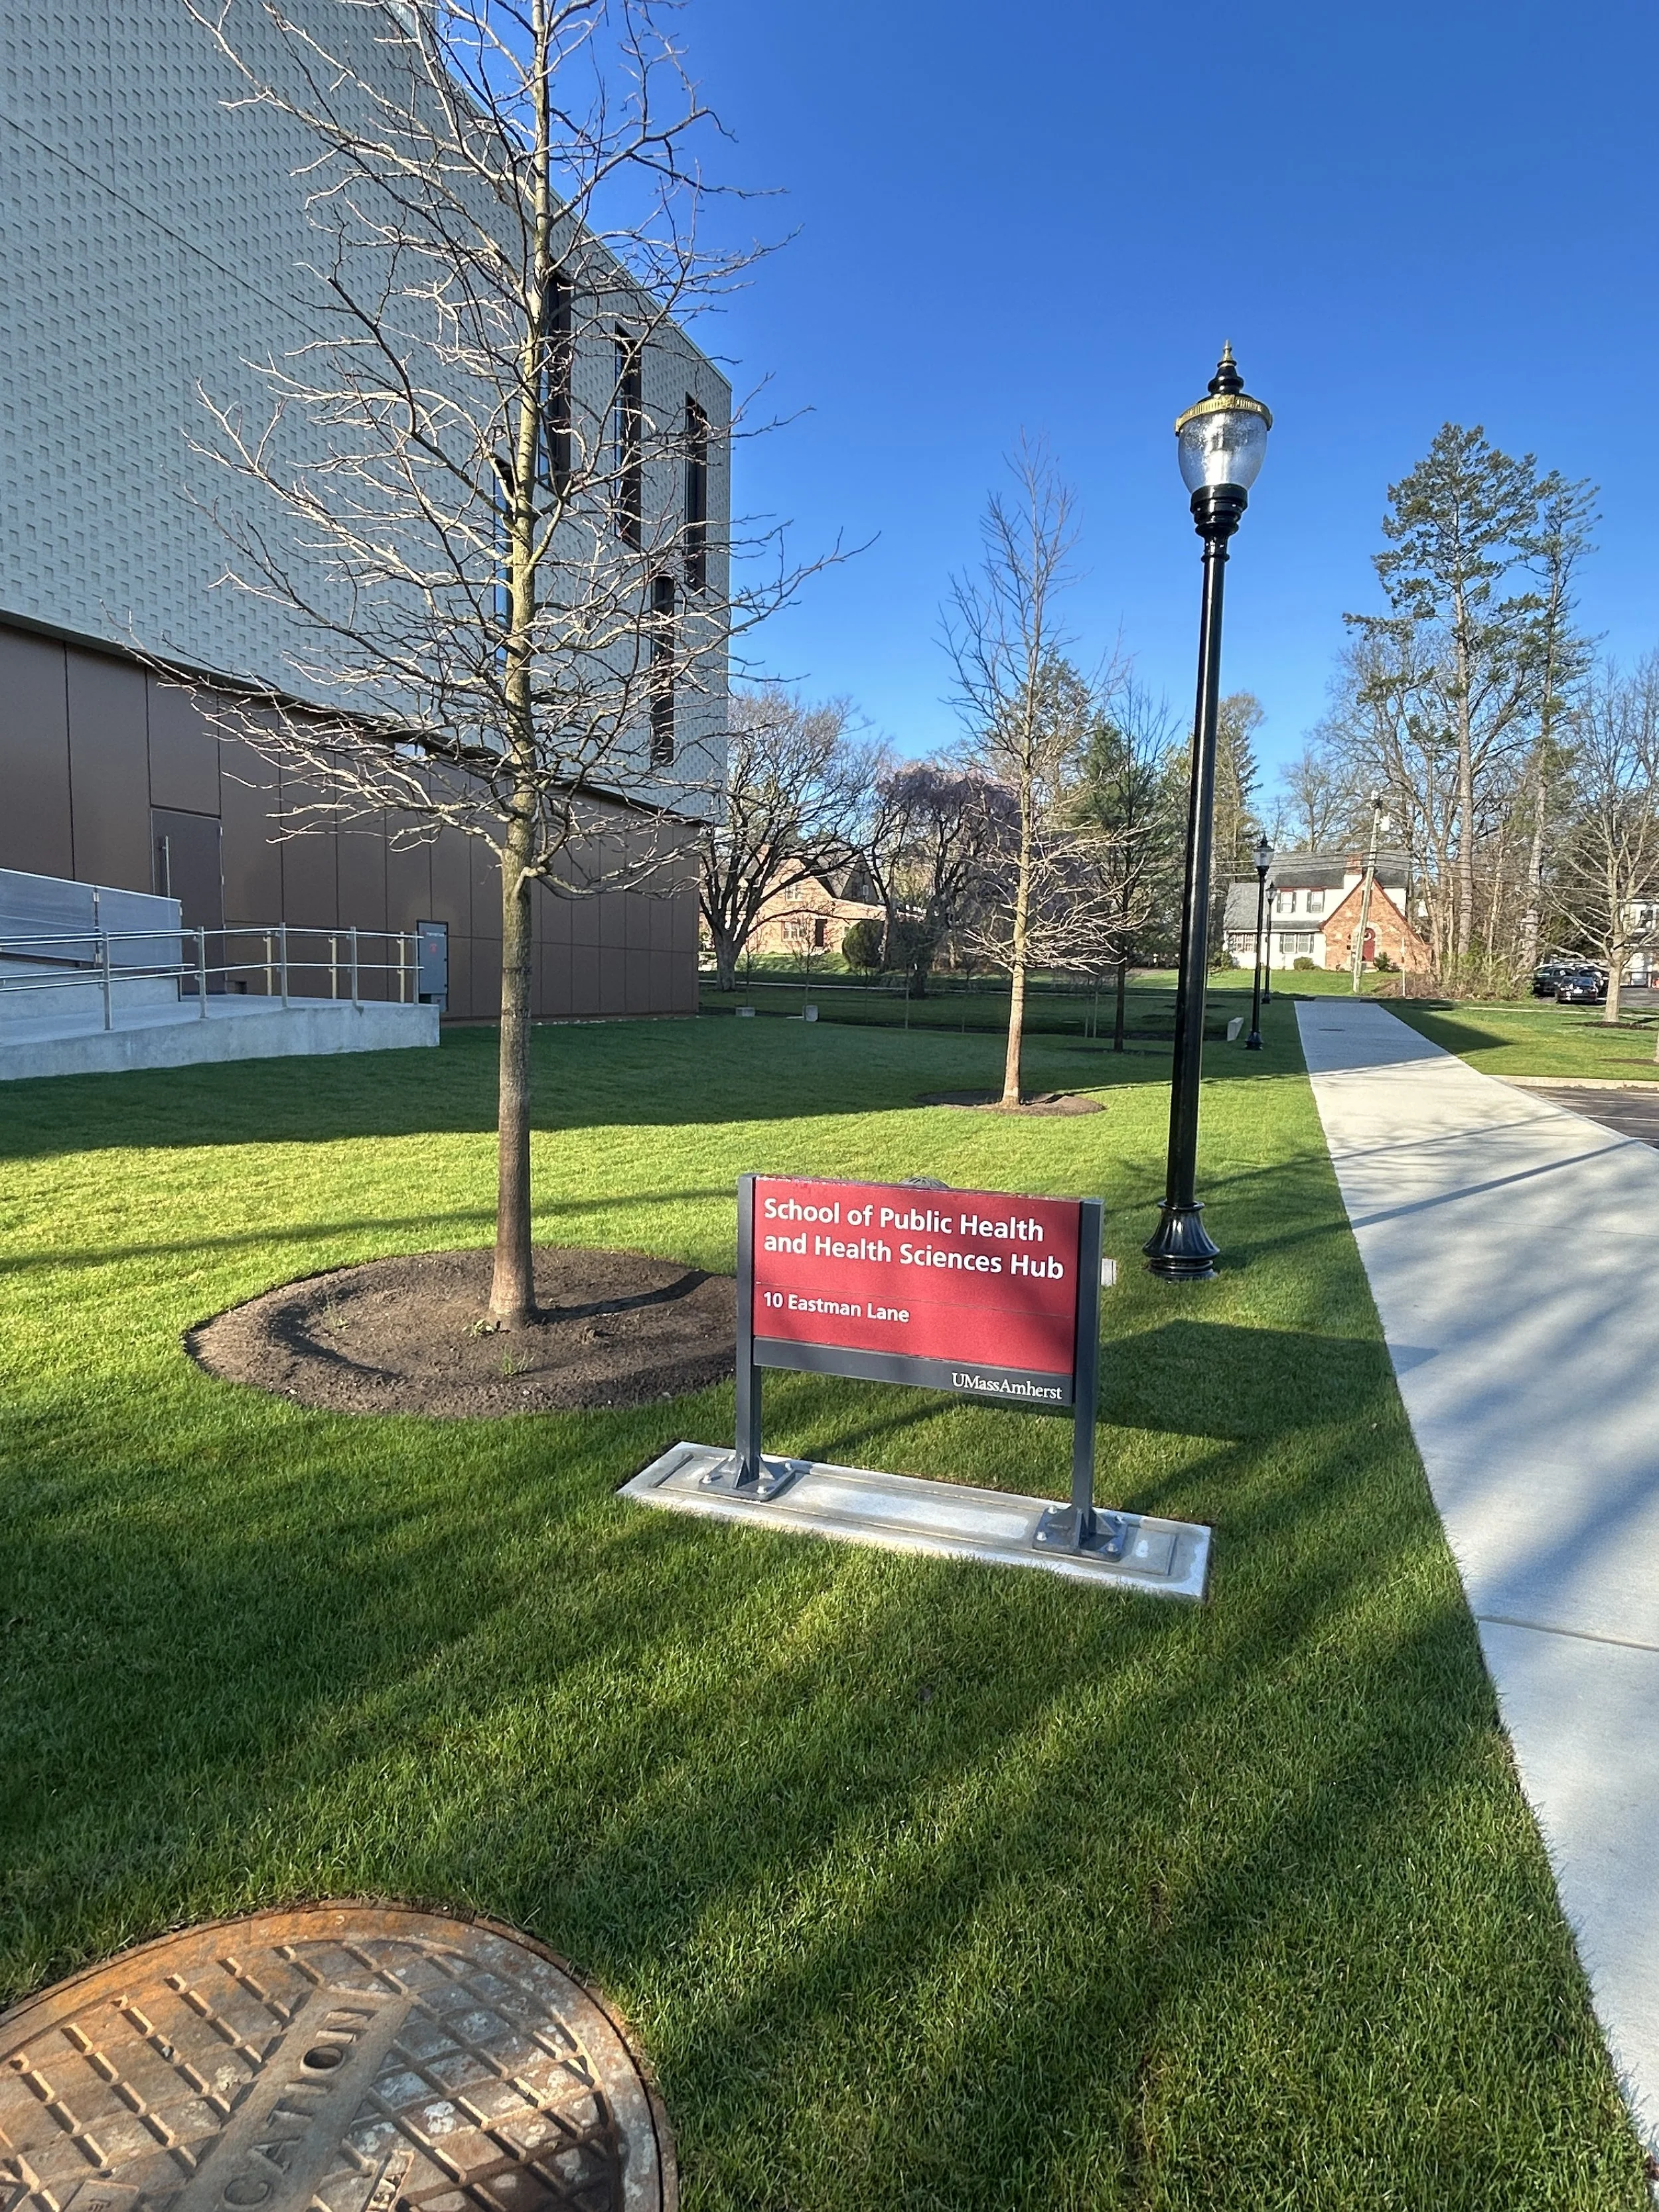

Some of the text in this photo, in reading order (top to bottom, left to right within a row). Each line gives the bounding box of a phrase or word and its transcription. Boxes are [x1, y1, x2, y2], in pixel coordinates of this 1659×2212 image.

[764, 1197, 1044, 1242] School of Public Health
[764, 1232, 1064, 1280] and Health Sciences Hub
[763, 1291, 910, 1323] 10 Eastman Lane
[219, 2006, 379, 2212] CATION
